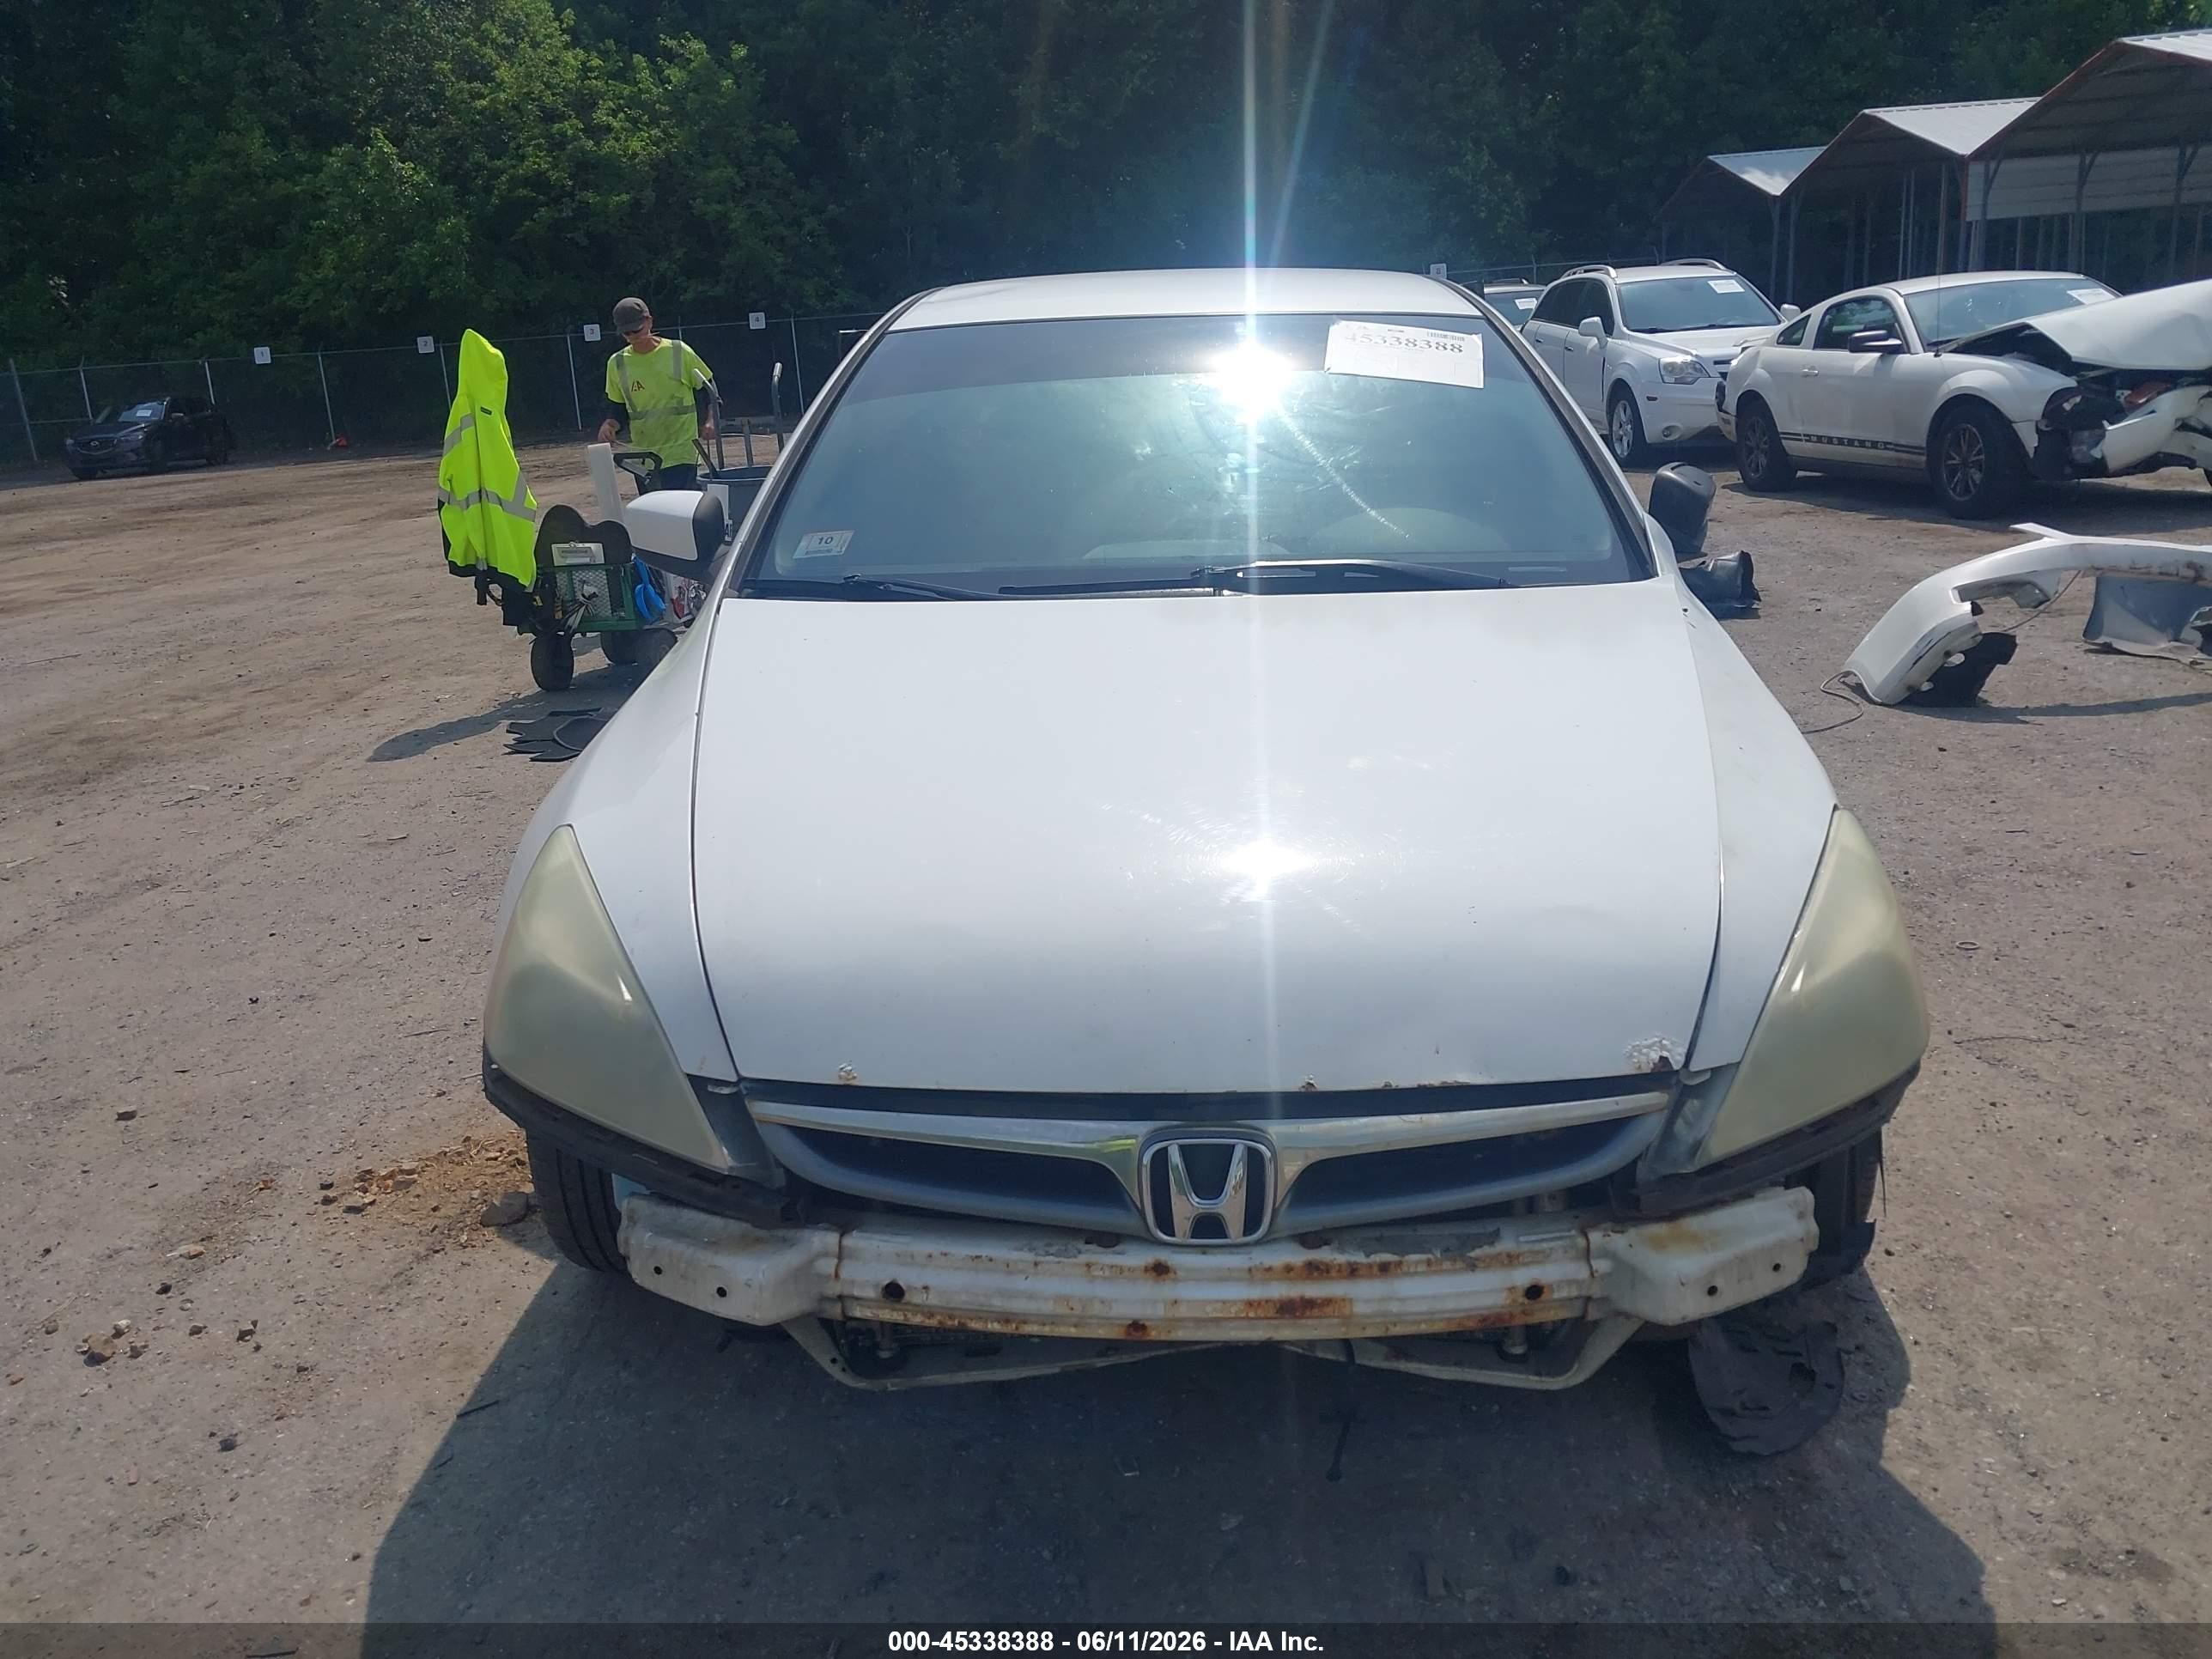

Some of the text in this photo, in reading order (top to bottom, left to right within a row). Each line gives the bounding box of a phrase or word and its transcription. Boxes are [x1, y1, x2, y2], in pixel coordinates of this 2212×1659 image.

[1346, 332, 1464, 354] 45338388
[1810, 435, 1885, 449] MUSTANG
[817, 536, 834, 545] 10
